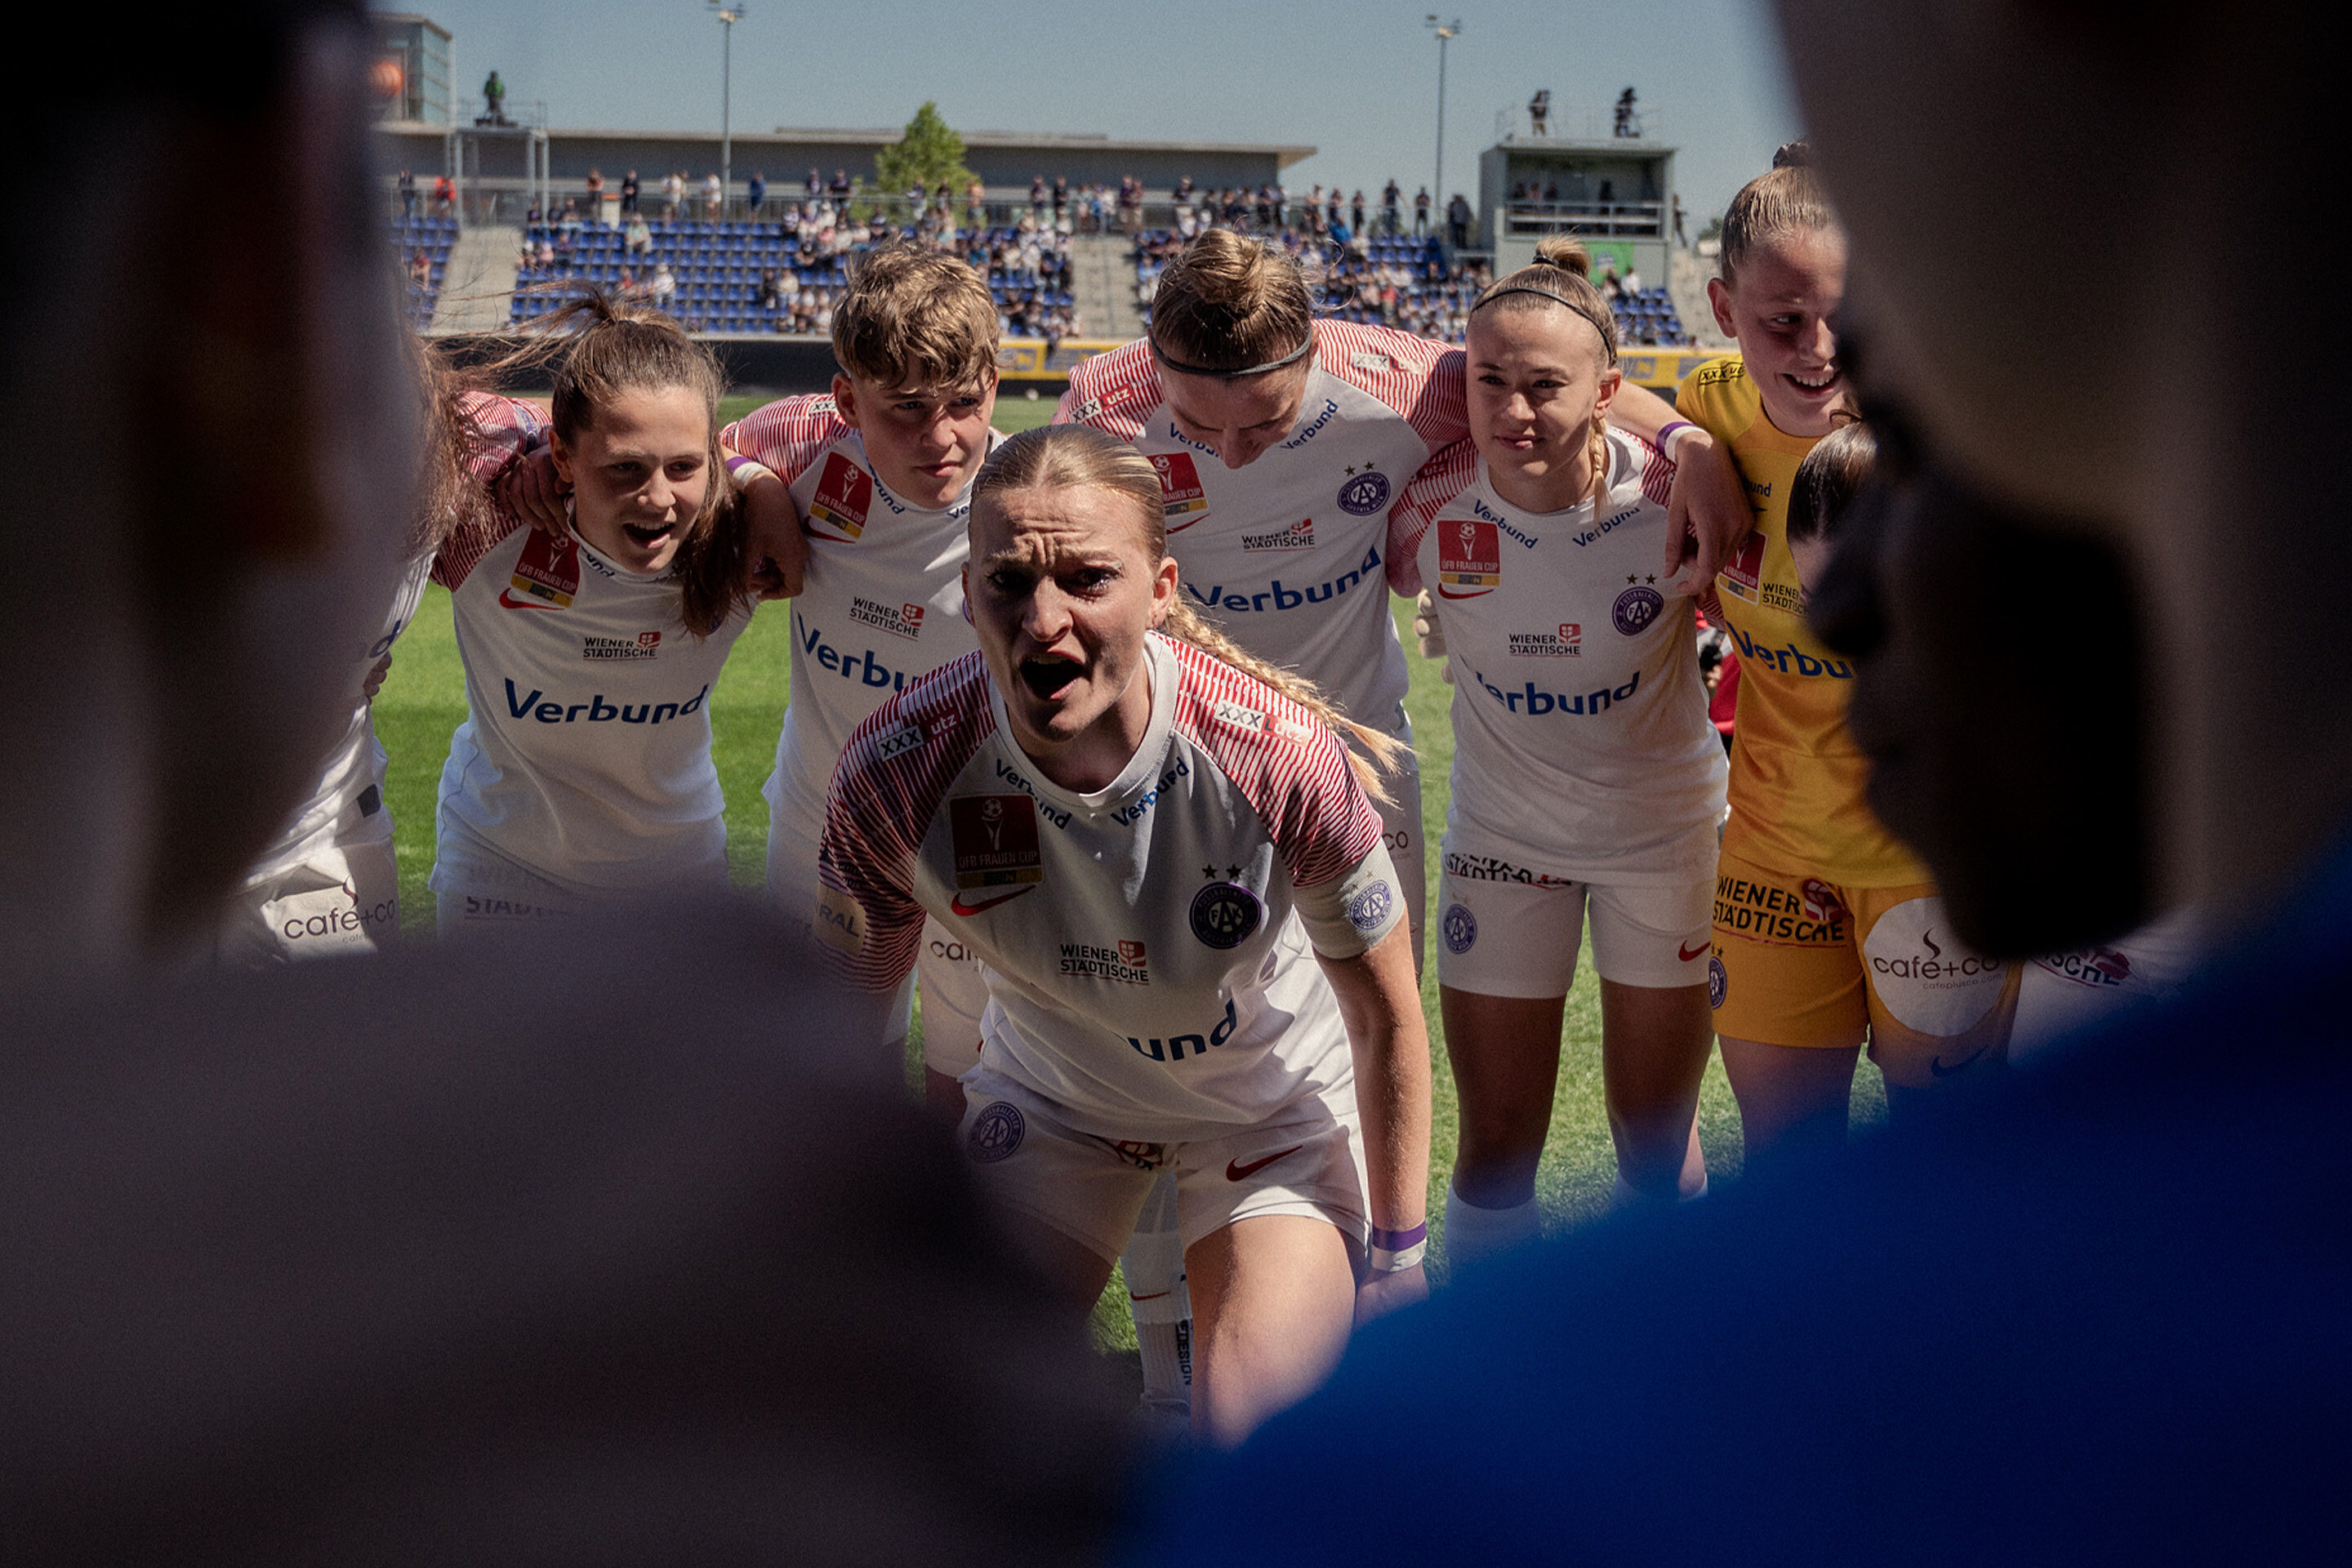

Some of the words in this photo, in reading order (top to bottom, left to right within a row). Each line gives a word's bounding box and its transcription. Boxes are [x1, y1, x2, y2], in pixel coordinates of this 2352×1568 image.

[1073, 388, 1130, 423] XXXLutz
[1281, 399, 1339, 448] Verbund
[1473, 499, 1539, 550] Verbund
[1456, 560, 1483, 571] FRAUEN
[1484, 562, 1498, 571] CUP
[1184, 545, 1382, 612] Verbund
[854, 597, 900, 621] WIENER
[850, 608, 920, 638] STÄDTISCHE
[585, 637, 634, 648] WIENER
[1509, 634, 1557, 645] WIENER
[1509, 643, 1580, 655] STÄDTISCHE
[583, 648, 657, 658] STÄDTISCHE
[504, 677, 710, 724] Verbund
[979, 851, 1017, 867] FRAUEN
[1018, 849, 1038, 864] CUP
[1717, 875, 1800, 915] WIENER
[1713, 900, 1845, 942] STÄDTISCHE
[1060, 943, 1120, 964] WIENER
[1060, 958, 1149, 982] STÄDTISCHE
